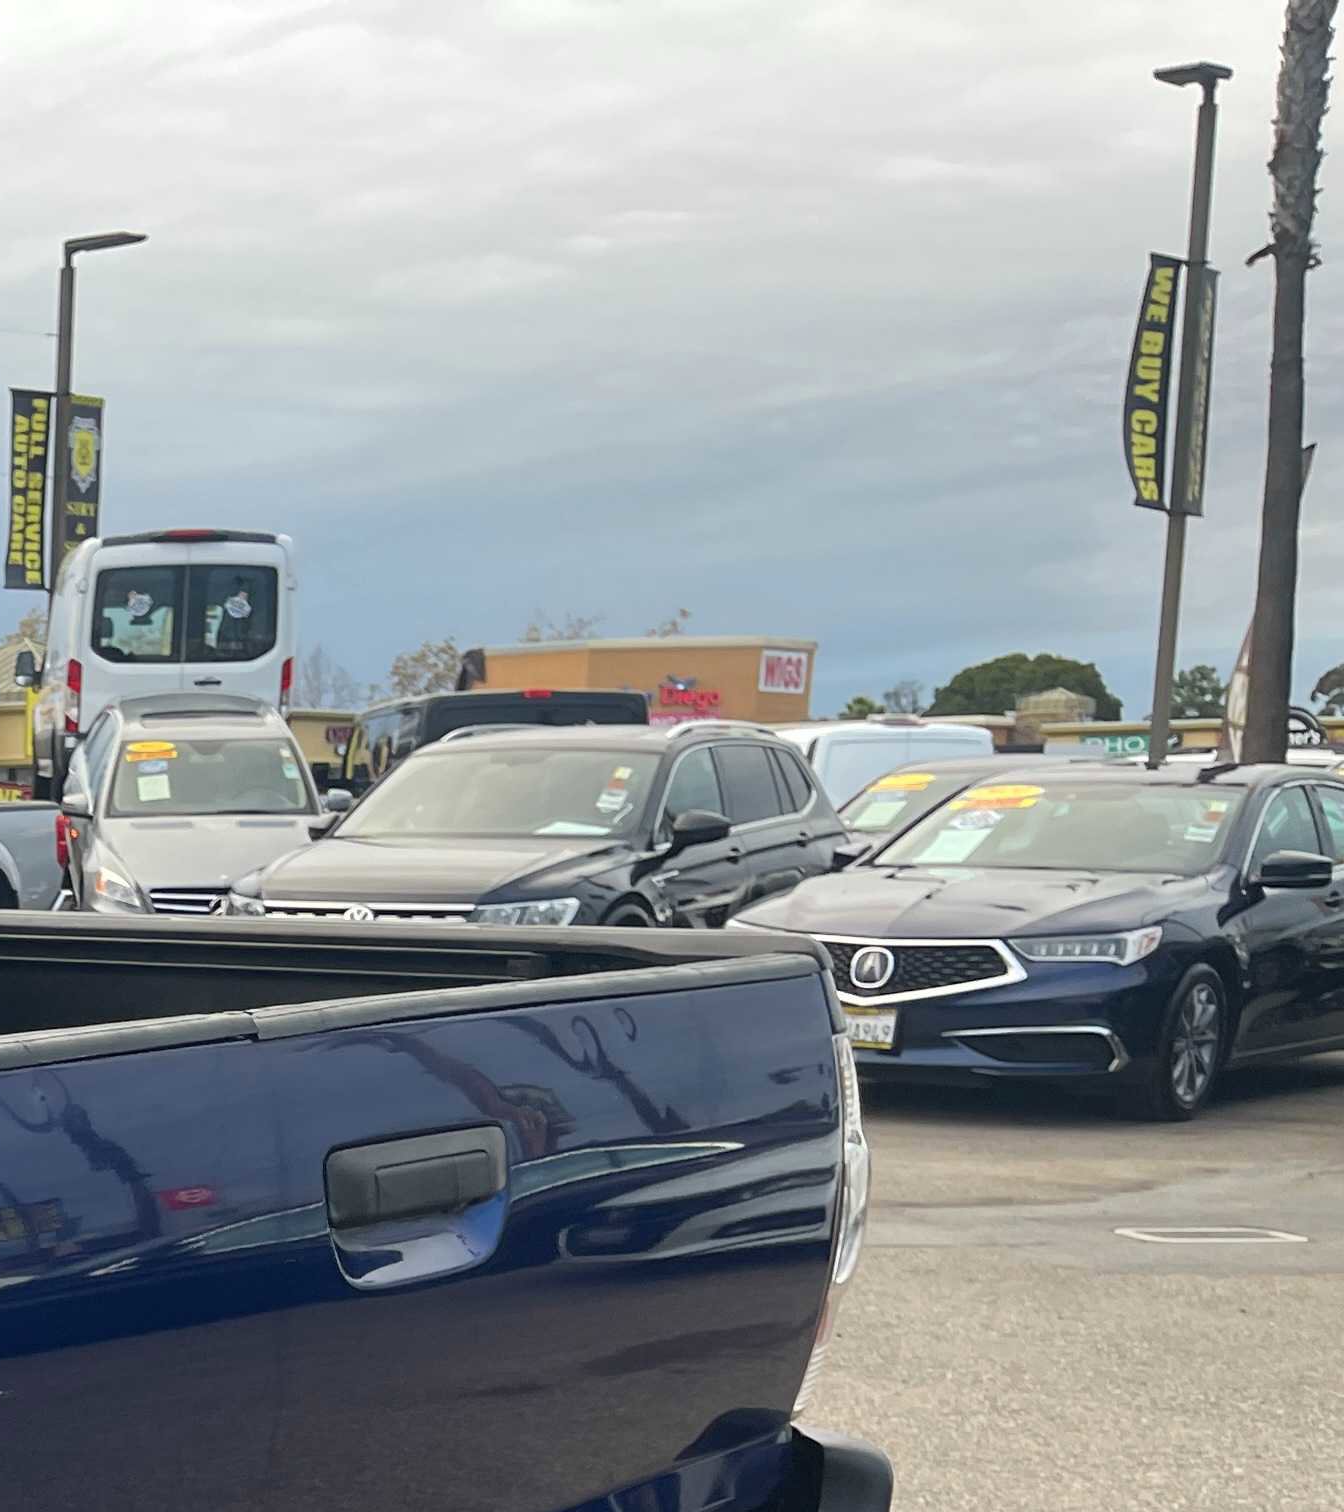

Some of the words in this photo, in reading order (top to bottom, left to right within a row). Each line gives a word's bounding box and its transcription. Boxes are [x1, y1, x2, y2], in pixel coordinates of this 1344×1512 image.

[1146, 266, 1174, 323] WE
[1133, 330, 1165, 404] BUY
[14, 414, 30, 488] AUTO
[1131, 409, 1158, 501] CARS
[765, 656, 802, 689] WIGS
